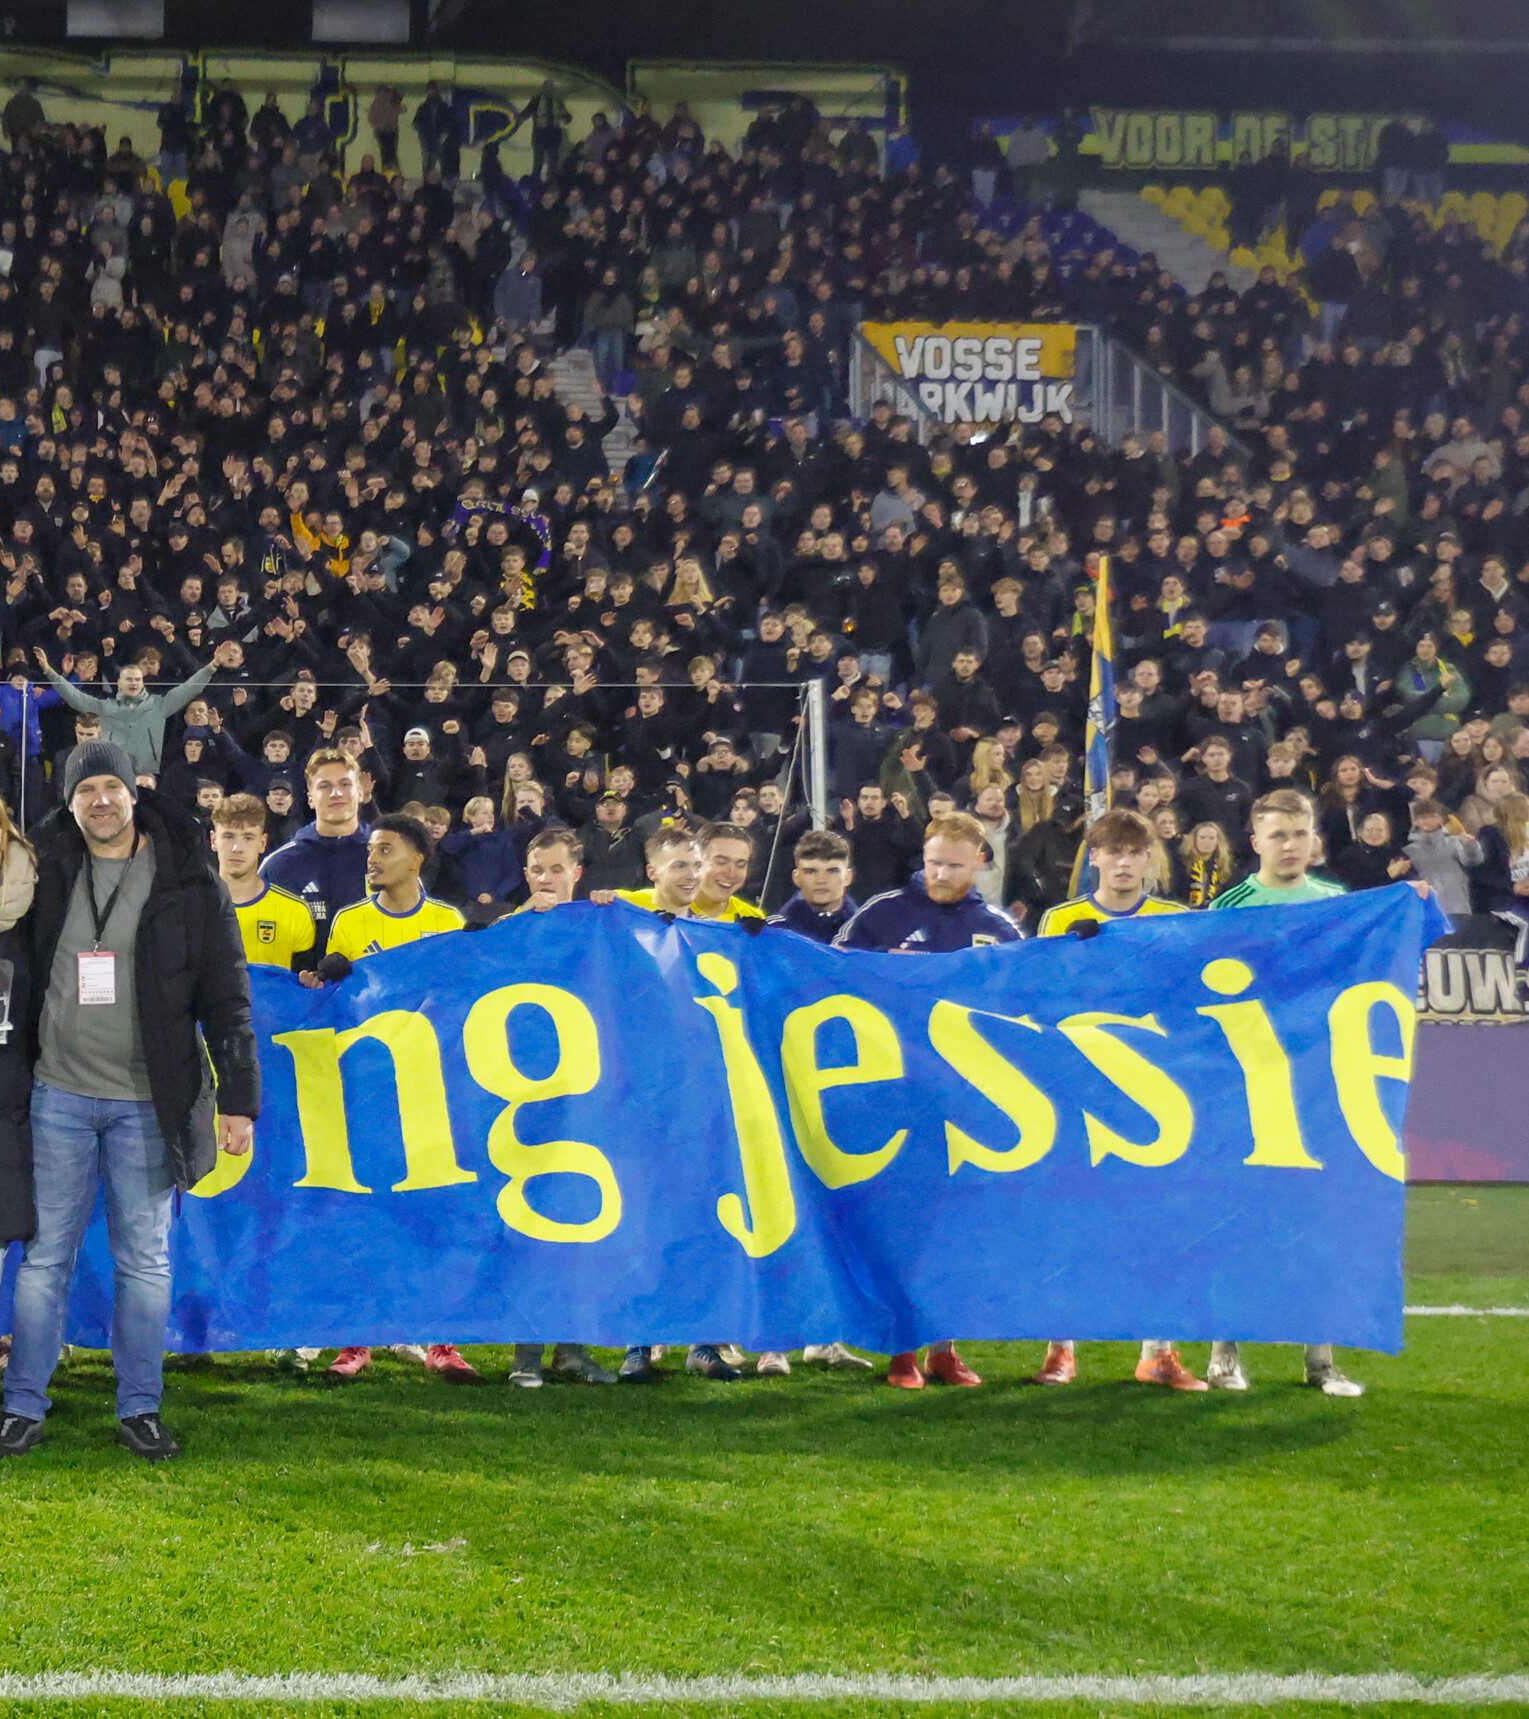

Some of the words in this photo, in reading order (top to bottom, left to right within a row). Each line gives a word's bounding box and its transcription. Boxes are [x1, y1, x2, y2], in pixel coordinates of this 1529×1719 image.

[1091, 108, 1217, 168] VOOR
[894, 336, 1042, 381] VOSSE
[695, 952, 1418, 1258] jessie
